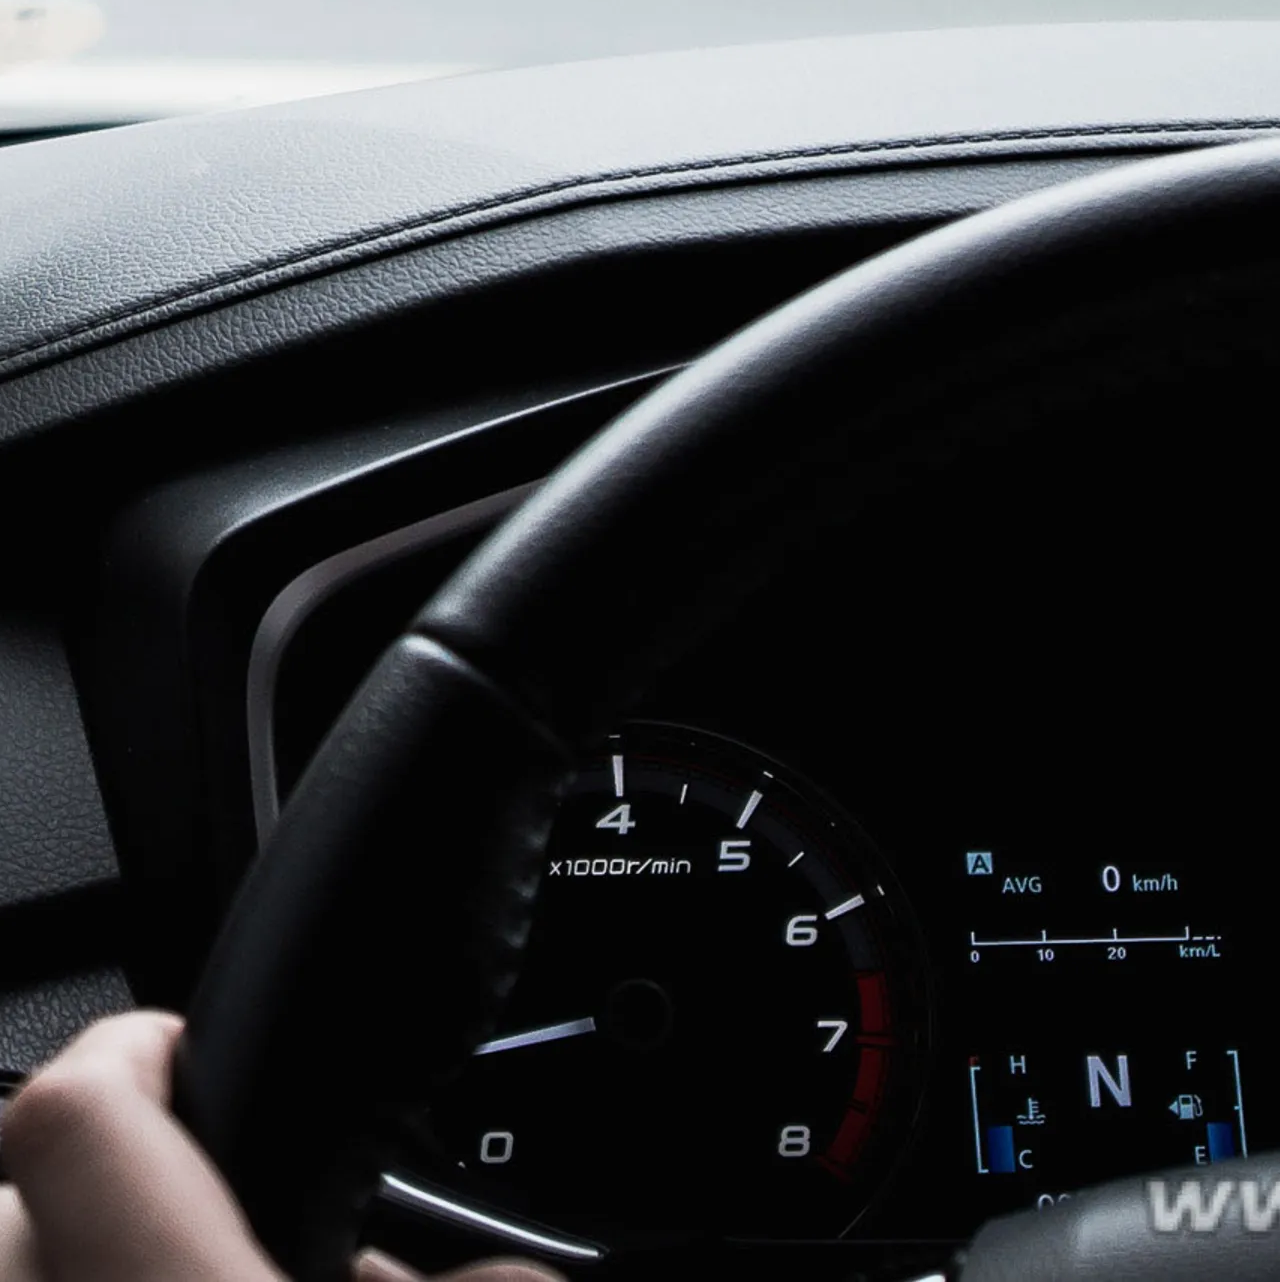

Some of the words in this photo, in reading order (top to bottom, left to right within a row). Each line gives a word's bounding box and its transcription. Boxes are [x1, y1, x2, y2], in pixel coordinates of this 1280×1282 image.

[596, 804, 636, 835] 4
[549, 857, 691, 876] x1000r/min
[718, 840, 751, 872] 5
[1001, 876, 1042, 894] AVG
[1102, 865, 1121, 892] 0
[1132, 874, 1178, 892] km/h
[785, 915, 818, 947] 6
[970, 950, 980, 963] 0
[1037, 948, 1055, 962] 10
[1107, 946, 1127, 960] 20
[1179, 942, 1221, 959] km/L
[816, 1020, 848, 1052] 7
[1009, 1055, 1027, 1075] H
[1185, 1050, 1197, 1070] F
[1086, 1054, 1132, 1108] N
[480, 1131, 514, 1164] 0
[778, 1125, 811, 1157] 8
[1018, 1149, 1033, 1169] C
[1194, 1145, 1207, 1165] E
